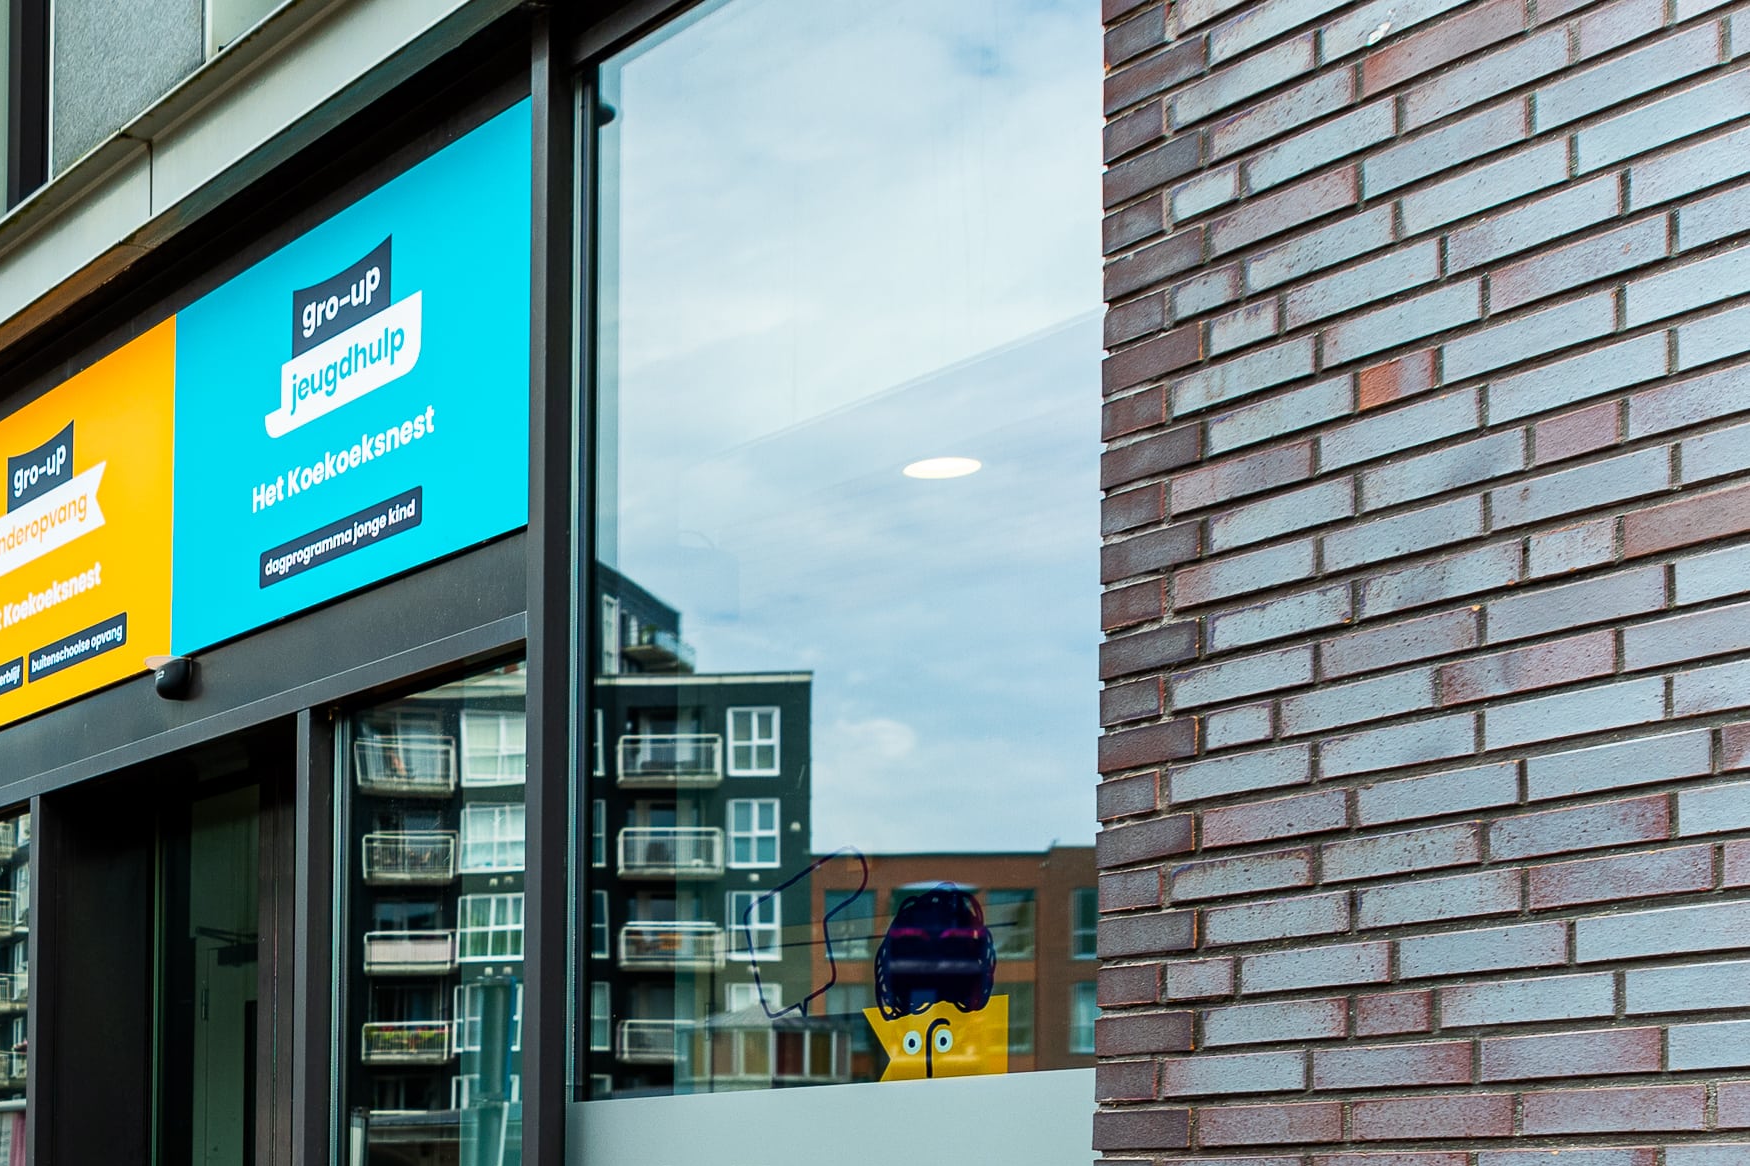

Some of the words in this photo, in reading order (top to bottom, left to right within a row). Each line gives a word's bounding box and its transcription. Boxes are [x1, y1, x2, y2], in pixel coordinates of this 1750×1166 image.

[302, 266, 381, 338] gro-up
[290, 327, 405, 416] jeugdhulp
[13, 445, 67, 498] gro-up
[252, 475, 285, 514] Het
[287, 405, 435, 498] Koekoeksnest
[264, 528, 352, 576] dagprogramma
[352, 513, 387, 546] jonge
[388, 498, 416, 525] kind
[3, 561, 102, 629] Koekoeksnest
[31, 638, 91, 674] buitenschoolse
[91, 624, 123, 651] opvang
